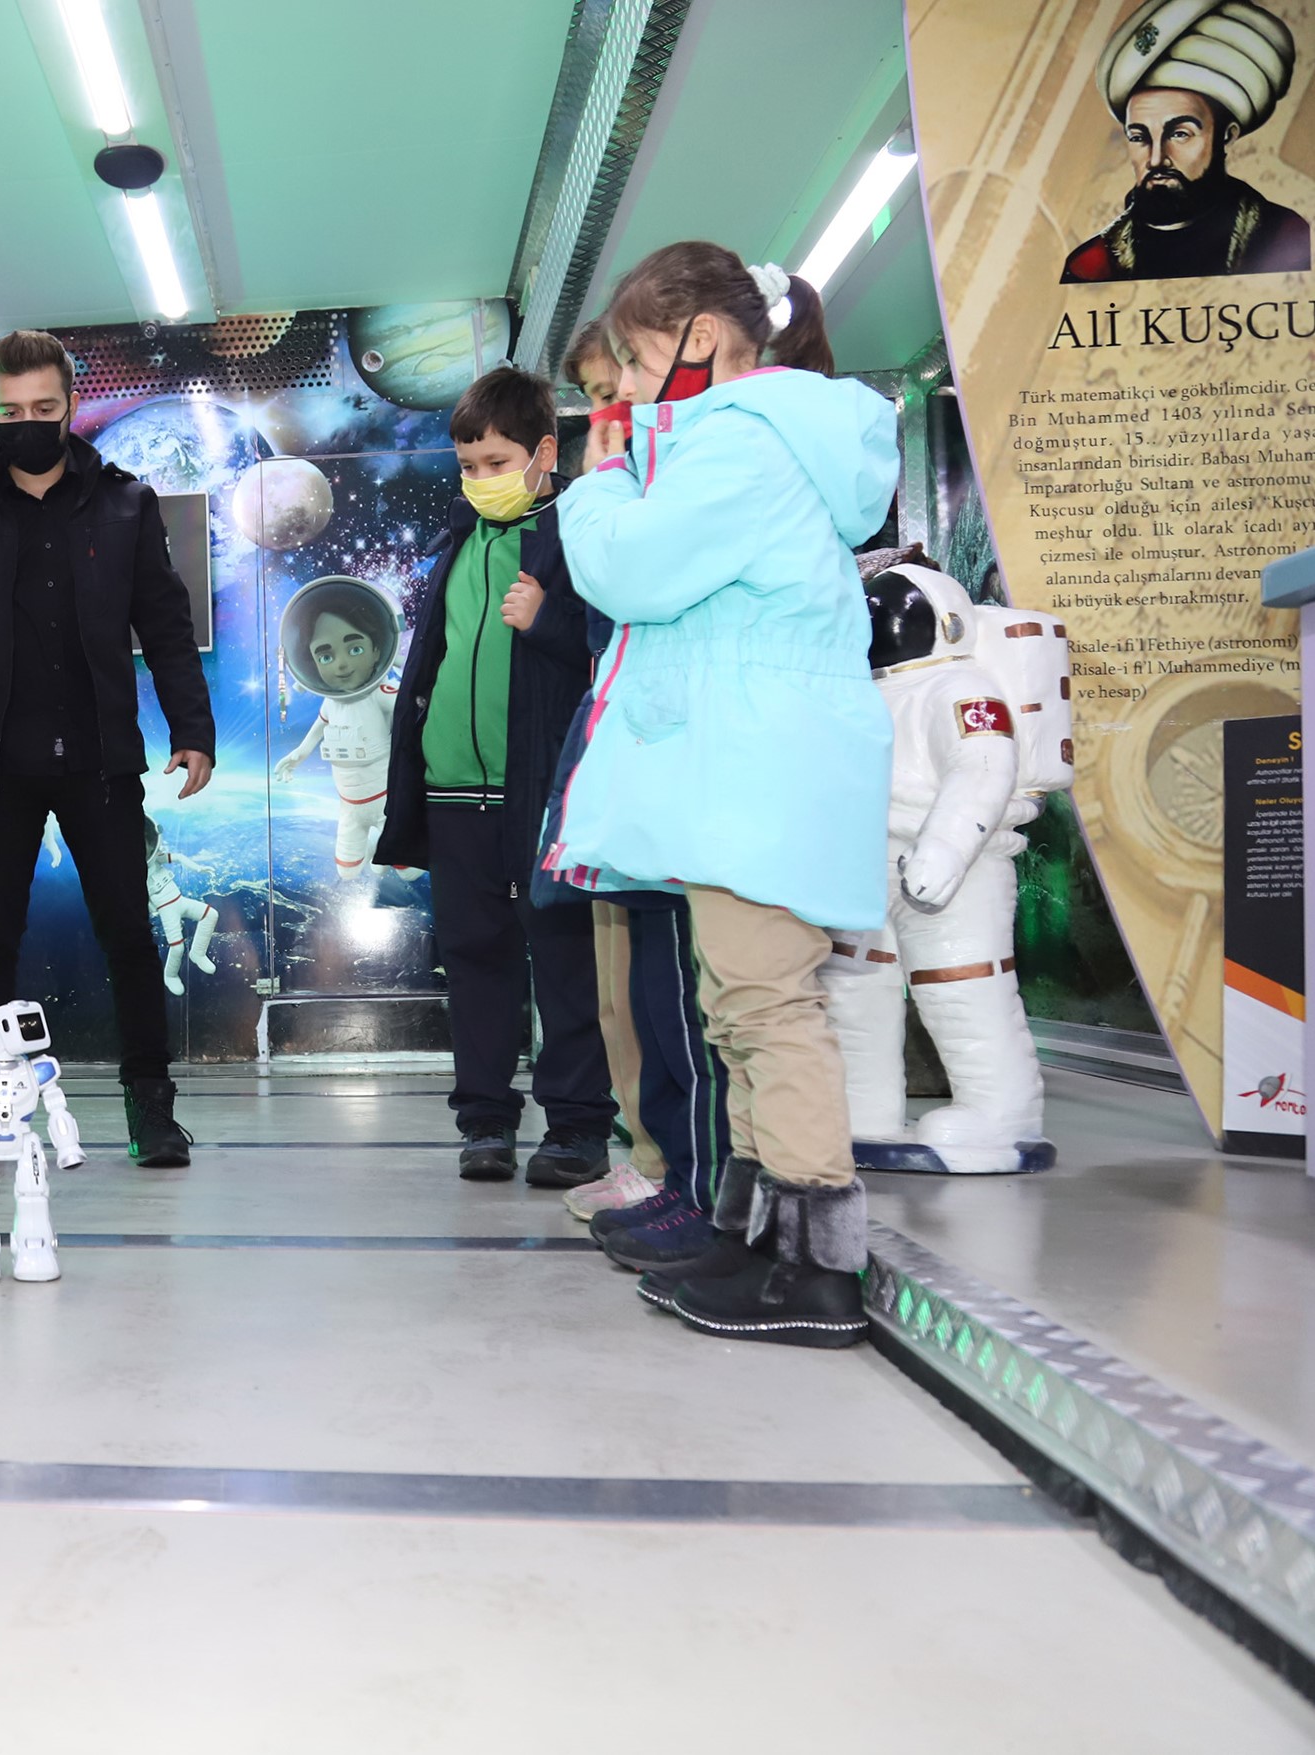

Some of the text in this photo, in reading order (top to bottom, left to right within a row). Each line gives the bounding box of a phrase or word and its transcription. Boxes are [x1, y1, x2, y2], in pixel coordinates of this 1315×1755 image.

[1019, 390, 1056, 404] Türk
[1060, 385, 1155, 402] matematikçi
[1159, 388, 1177, 398] ve
[1181, 380, 1291, 402] gökbilimcidir.
[1008, 413, 1037, 428] Bin
[1048, 408, 1150, 426] Muhammed
[1162, 406, 1202, 421] 1403
[1213, 403, 1276, 424] yılında
[1013, 436, 1113, 453] doğmuştur.
[1168, 427, 1271, 448] yüzyıllarda
[1018, 455, 1122, 473] insanlarından
[1129, 453, 1194, 469] birisidir.
[1202, 451, 1251, 466] Babası
[1023, 475, 1311, 497] İmparatorluğu Sultanı ve astronomu
[1029, 504, 1095, 519] Kuşcusu
[1104, 500, 1160, 517] olduğu
[1170, 500, 1201, 515] için
[1211, 497, 1253, 512] ailesi
[1035, 525, 1093, 542] meşhur
[1103, 523, 1142, 538] oldu.
[1152, 521, 1175, 537] İlk
[1184, 520, 1234, 535] olarak
[1244, 518, 1282, 533] icadı
[1040, 548, 1097, 566] çizmesi
[1104, 546, 1124, 561] ile
[1131, 546, 1205, 562] olmuştur.
[1214, 541, 1297, 558] Astronomi
[1045, 570, 1111, 585] alanında
[1114, 568, 1212, 586] çalışmalarını
[1052, 590, 1250, 611] iki büyük eser bırakmıştır.
[1148, 637, 1205, 655] Fethiye
[1208, 634, 1298, 652] (astronomi)
[1072, 662, 1128, 676] Risale-i
[1158, 659, 1275, 675] Muhammediye
[1078, 684, 1148, 701] ve hesap)
